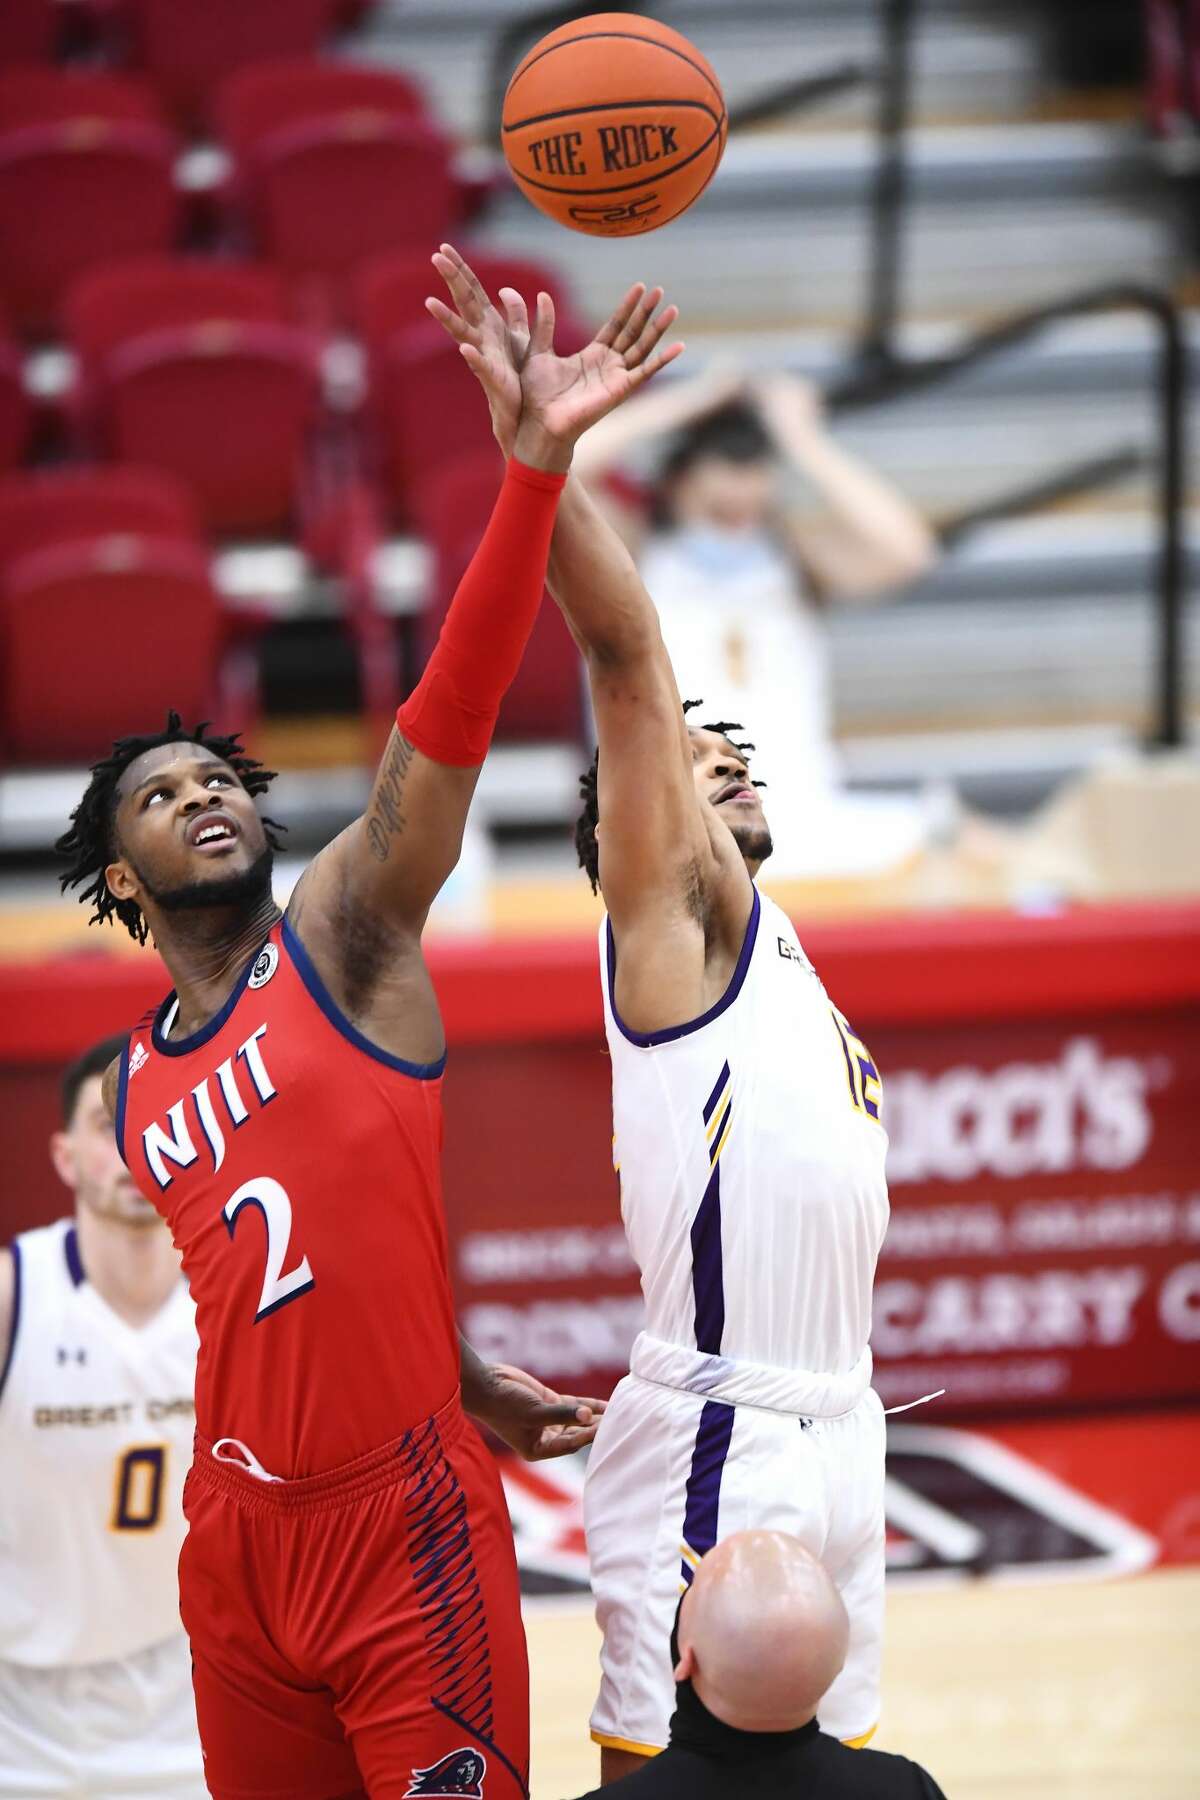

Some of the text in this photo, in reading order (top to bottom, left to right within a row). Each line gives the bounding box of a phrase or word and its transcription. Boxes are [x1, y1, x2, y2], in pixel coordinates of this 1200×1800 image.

[528, 124, 679, 176] THE ROCK
[141, 1023, 278, 1192] NJIT
[221, 1176, 315, 1326] 2
[109, 1442, 169, 1534] 0
